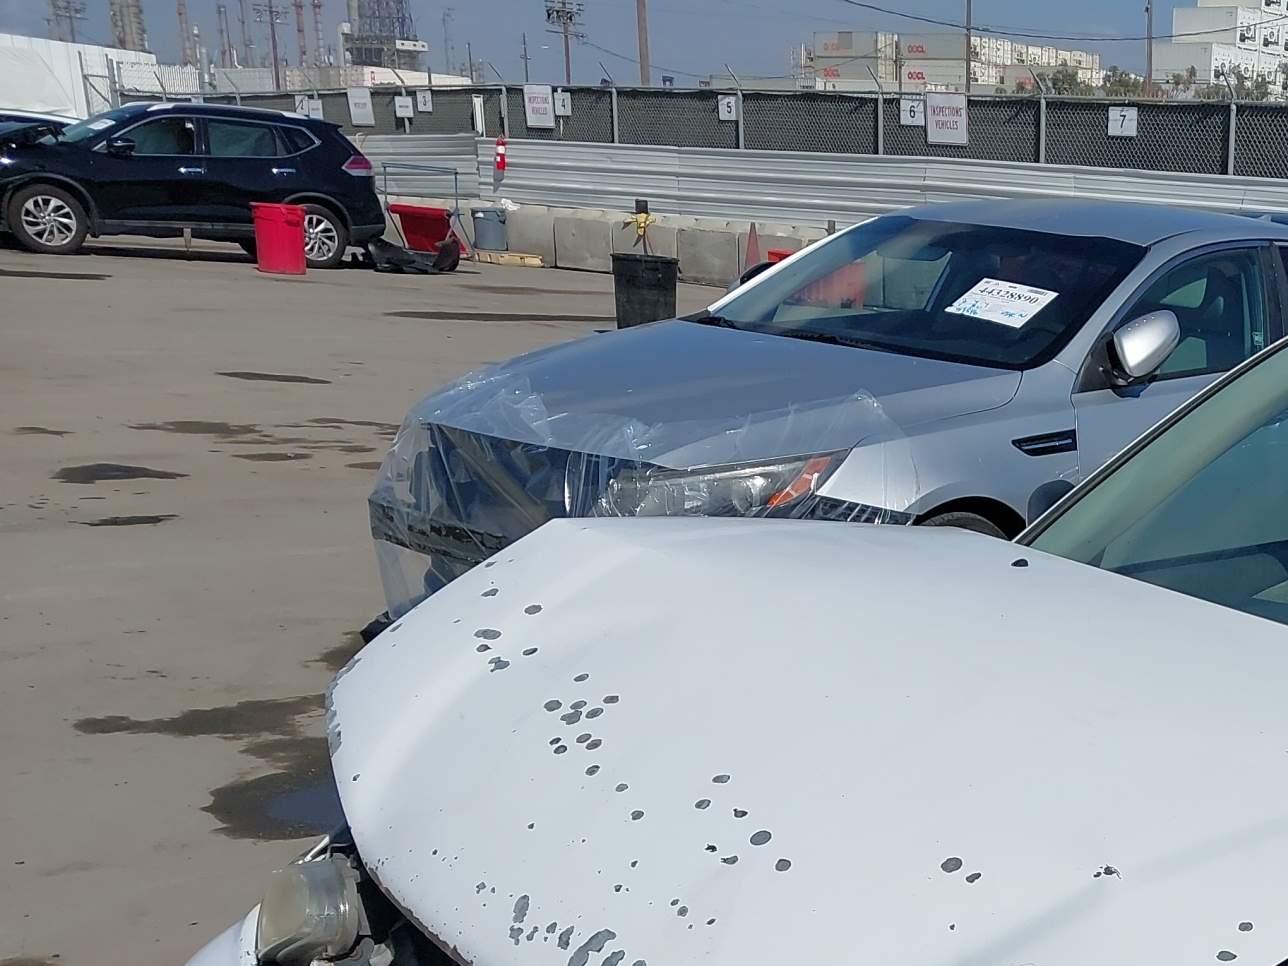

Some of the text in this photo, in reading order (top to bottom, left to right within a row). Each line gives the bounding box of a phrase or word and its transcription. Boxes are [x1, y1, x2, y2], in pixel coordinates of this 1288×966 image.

[560, 98, 566, 110] 4
[726, 102, 732, 114] 5
[909, 105, 916, 119] 6
[934, 120, 959, 130] VEHICLES
[1119, 114, 1127, 129] 7
[978, 287, 1040, 305] 44328890
